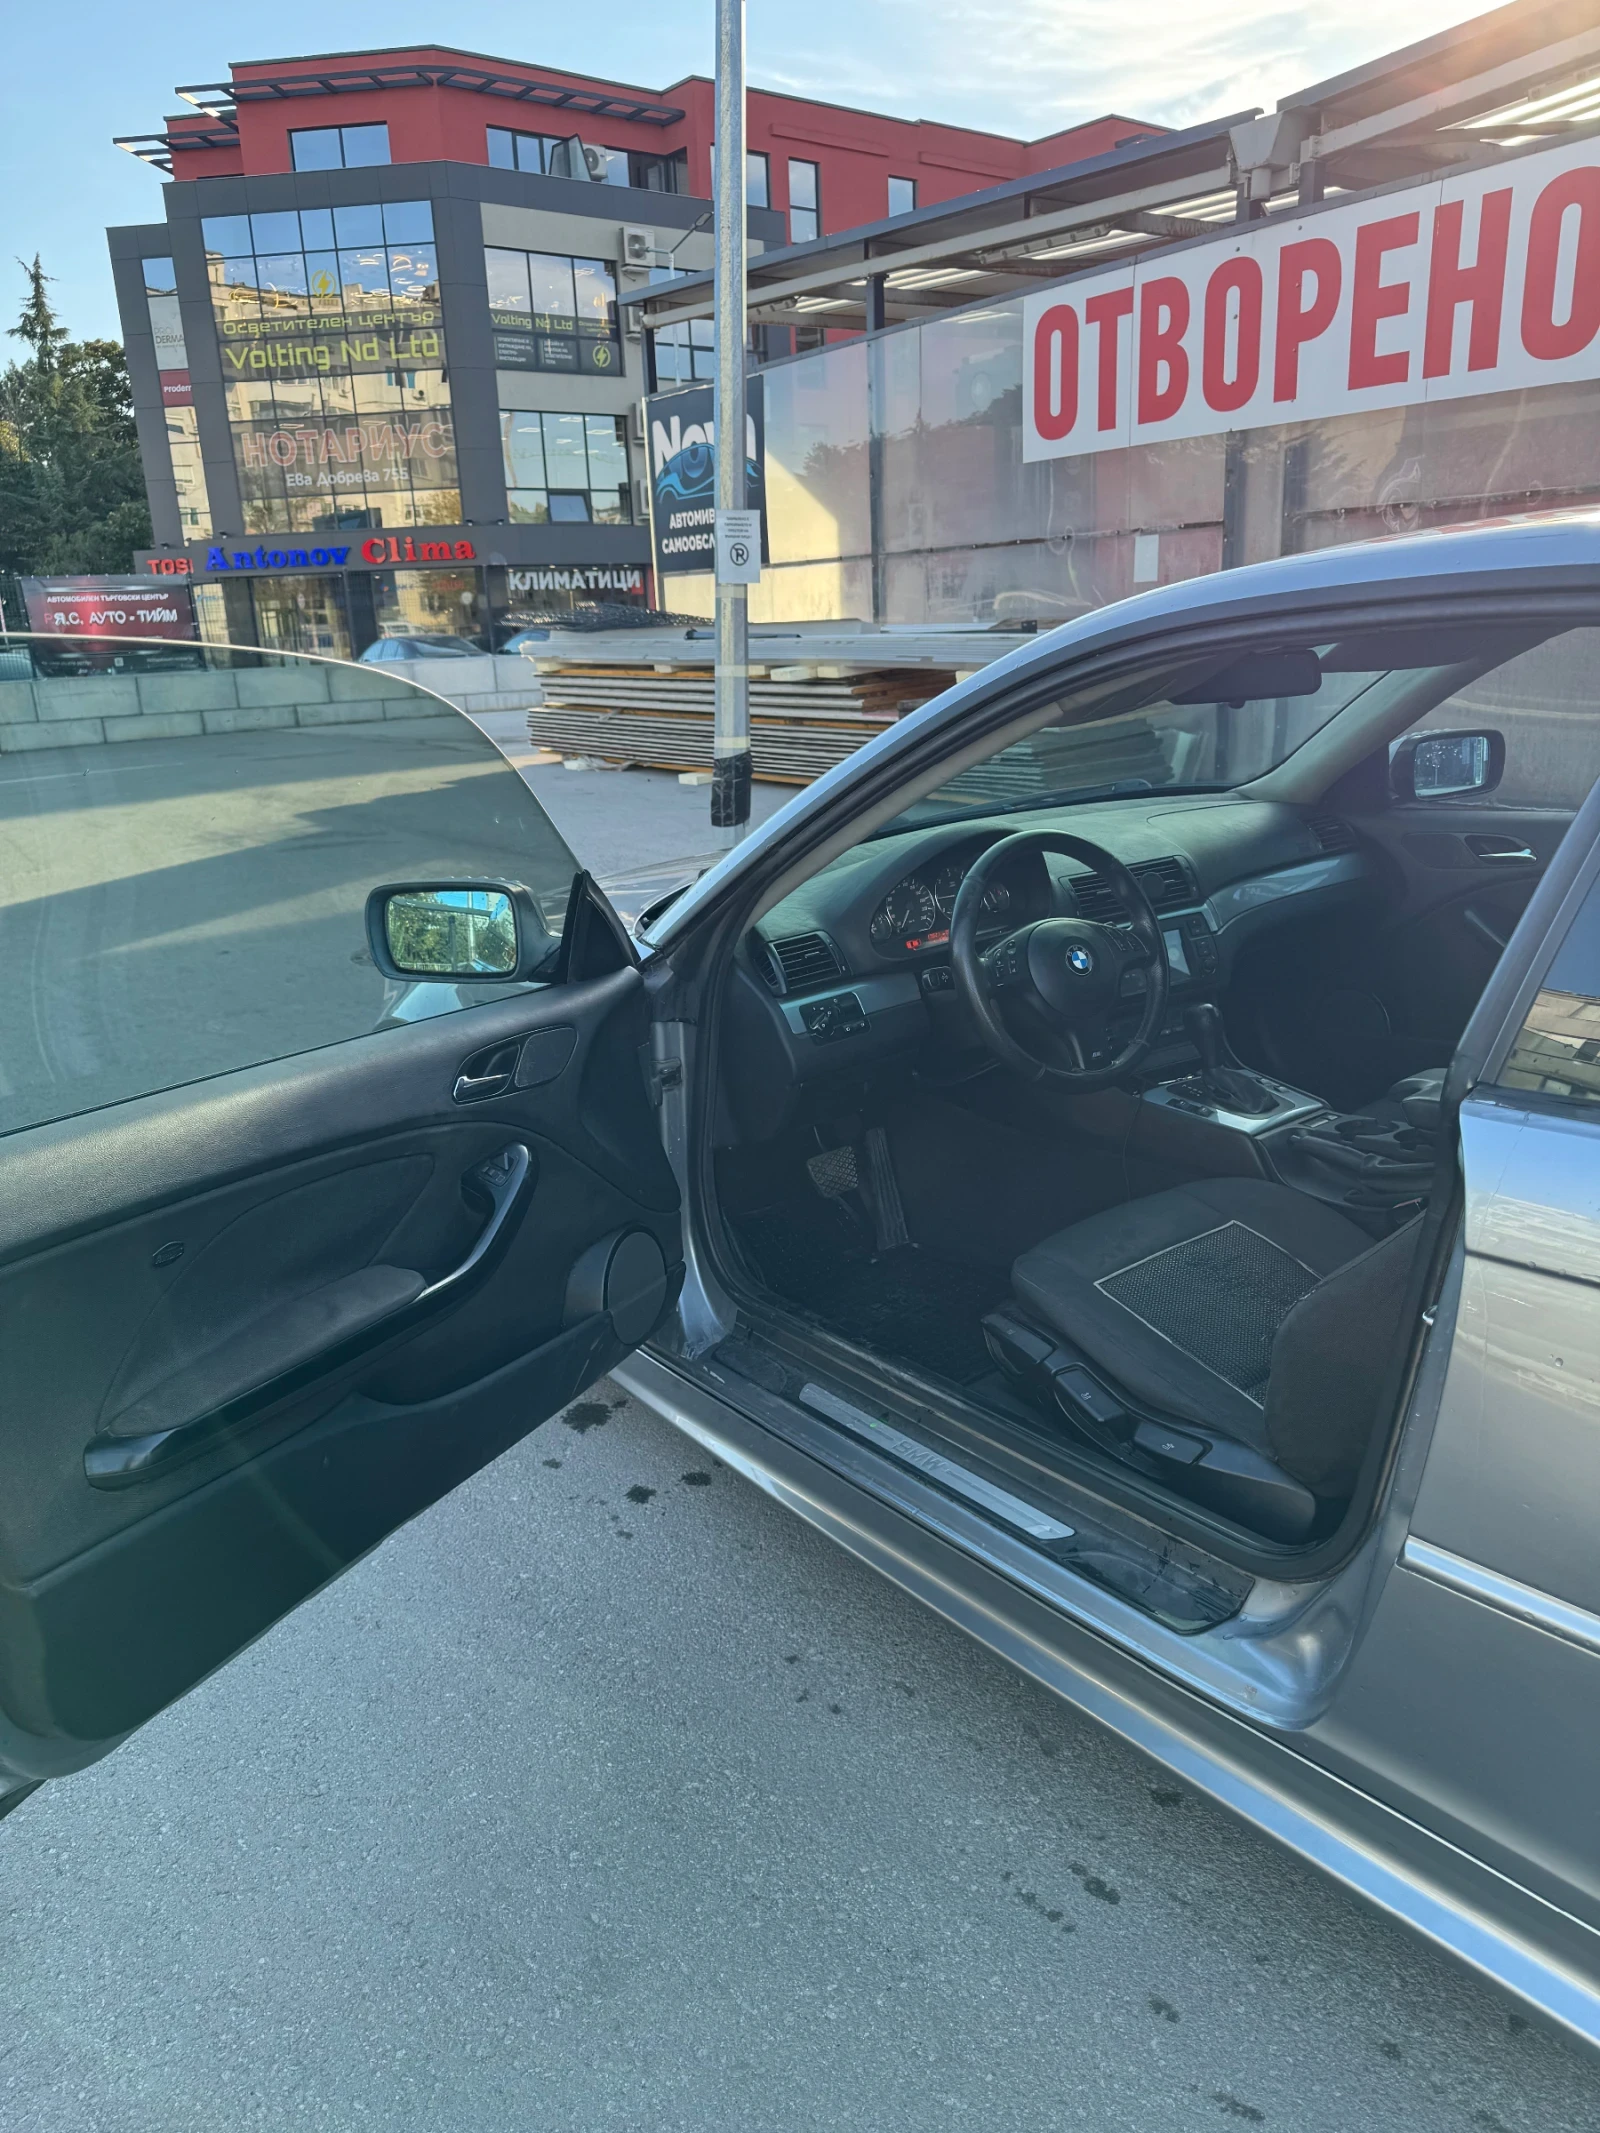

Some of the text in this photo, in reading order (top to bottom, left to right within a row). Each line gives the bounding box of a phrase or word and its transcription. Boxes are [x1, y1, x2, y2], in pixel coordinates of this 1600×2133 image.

[1034, 166, 1600, 441] ОТВОРЕНО
[223, 310, 435, 335] Осветителен център
[491, 313, 532, 329] Volting
[554, 320, 573, 330] Ltd
[226, 333, 439, 371] Volting Nd Ltd
[241, 422, 447, 468] НОТАРИУС
[287, 472, 313, 487] Ева
[317, 469, 380, 488] Добрева
[669, 508, 715, 529] АВТОМИВ
[206, 536, 476, 572] Antonov Clima
[662, 532, 715, 554] САМООБСЛ
[508, 570, 640, 591] КЛИМАТИЦИ
[141, 593, 169, 601] ЦЕНТЪР
[89, 611, 126, 625] АУТО
[137, 607, 178, 623] ТИЙМ
[891, 1440, 948, 1471] BMW
